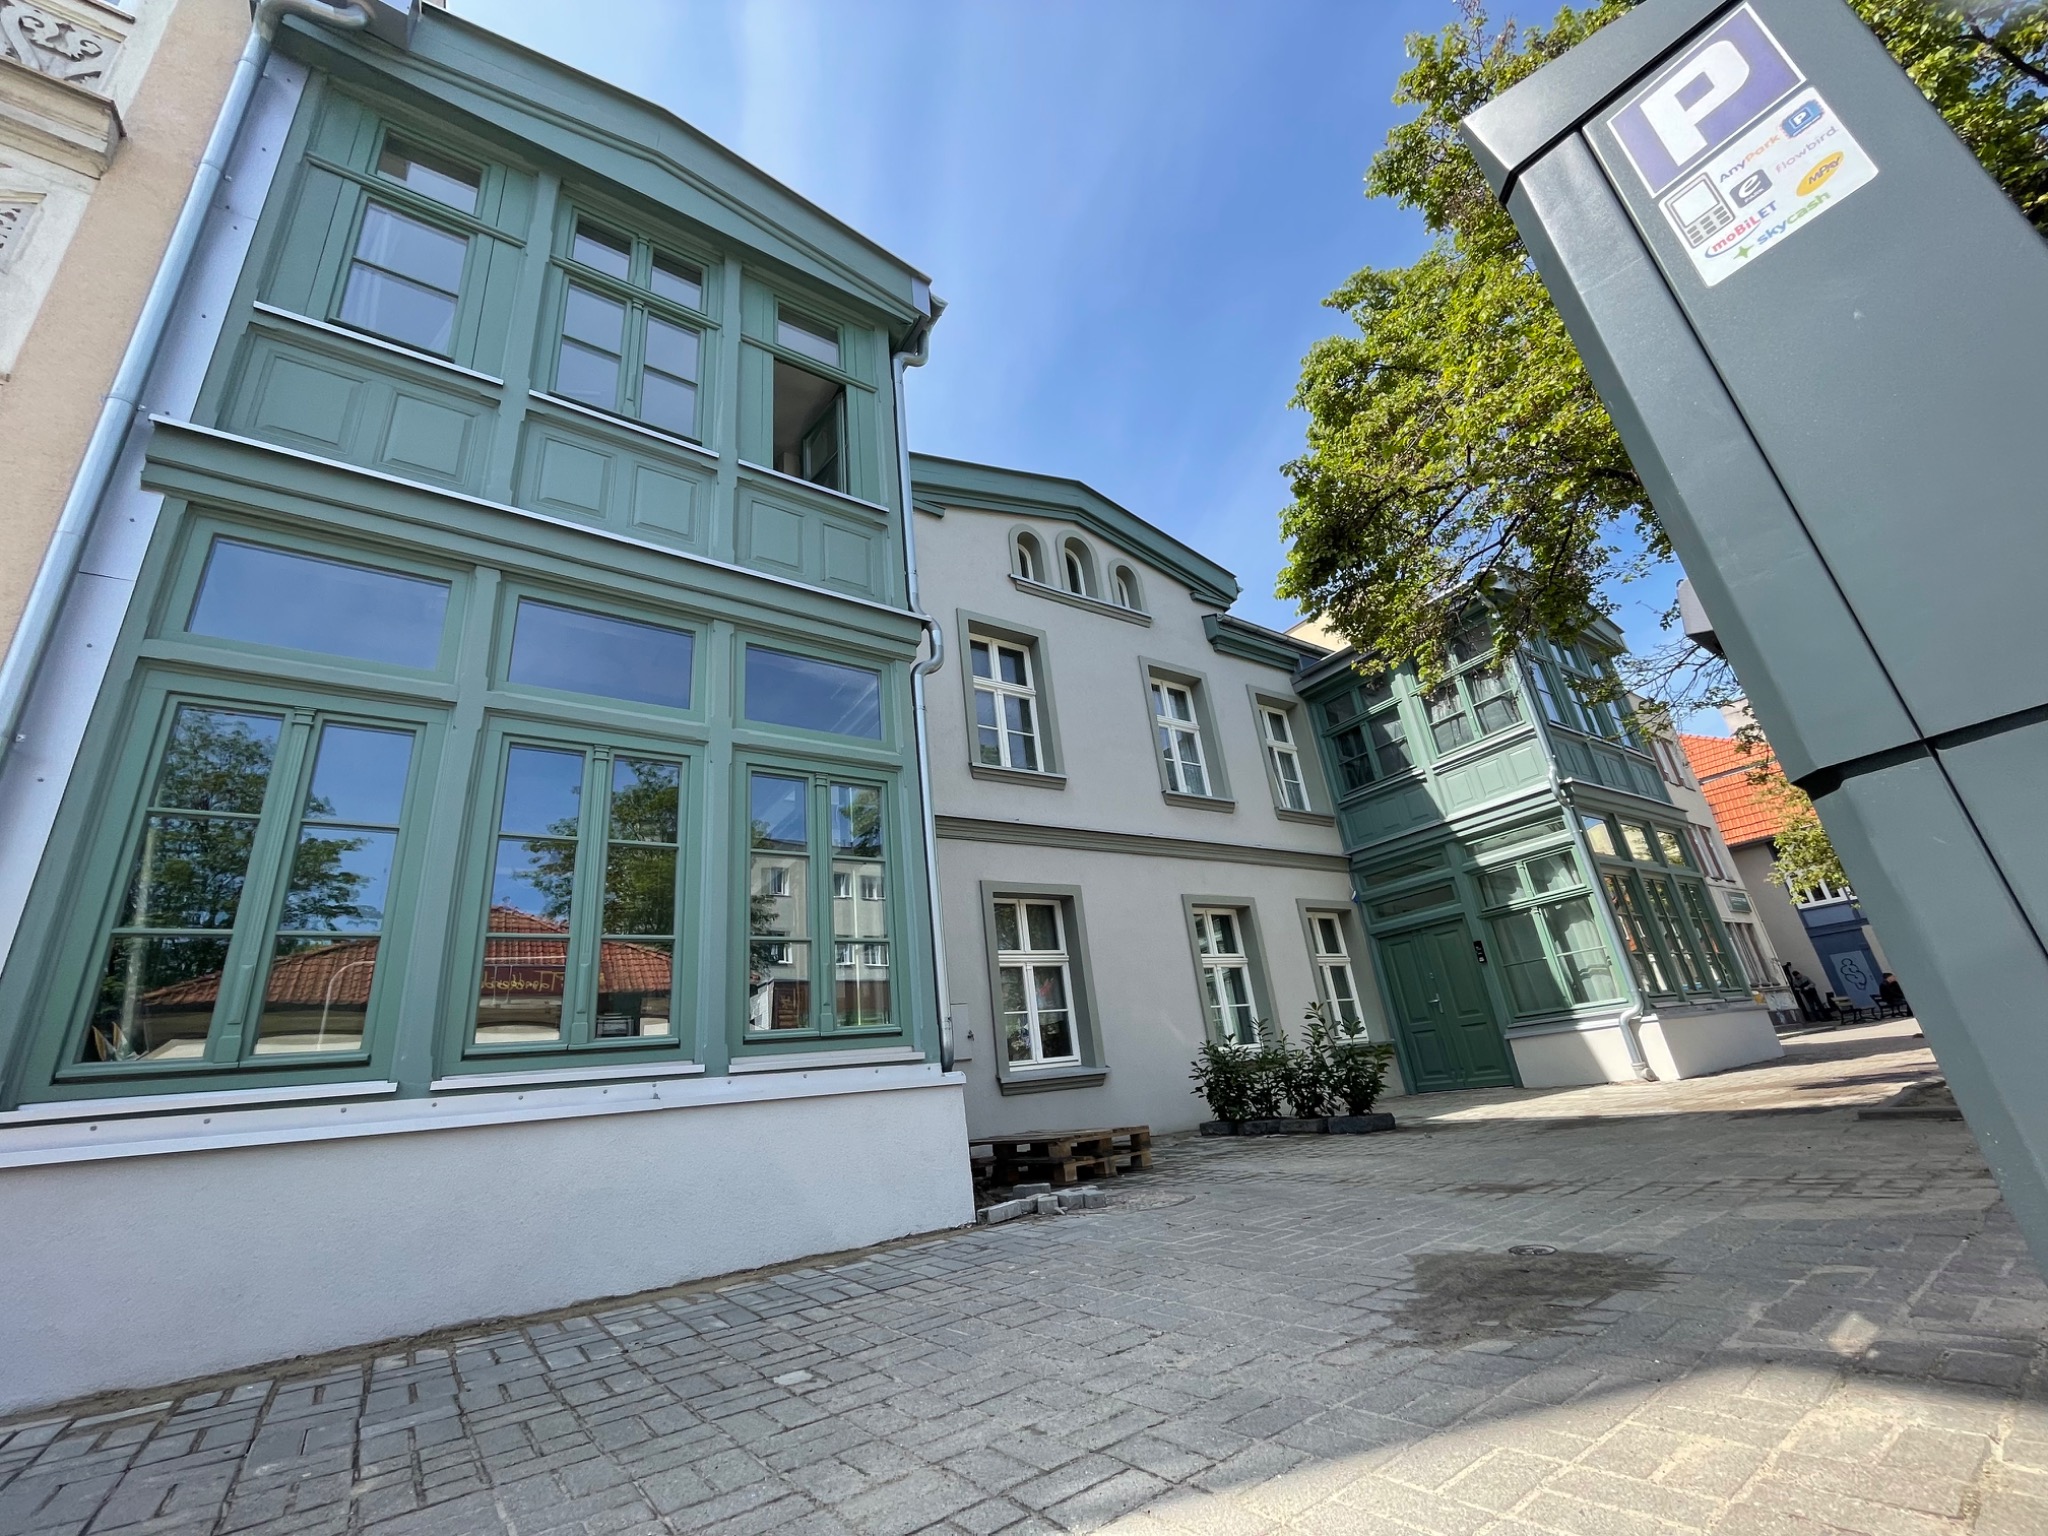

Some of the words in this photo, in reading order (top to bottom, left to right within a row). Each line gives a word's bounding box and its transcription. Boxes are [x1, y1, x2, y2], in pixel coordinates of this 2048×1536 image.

[1640, 40, 1749, 166] P
[1793, 112, 1807, 125] P
[1719, 134, 1781, 183] AnyPark
[1775, 126, 1838, 174] flowbird
[1711, 200, 1777, 252] moBiLET
[1757, 192, 1831, 245] skycash
